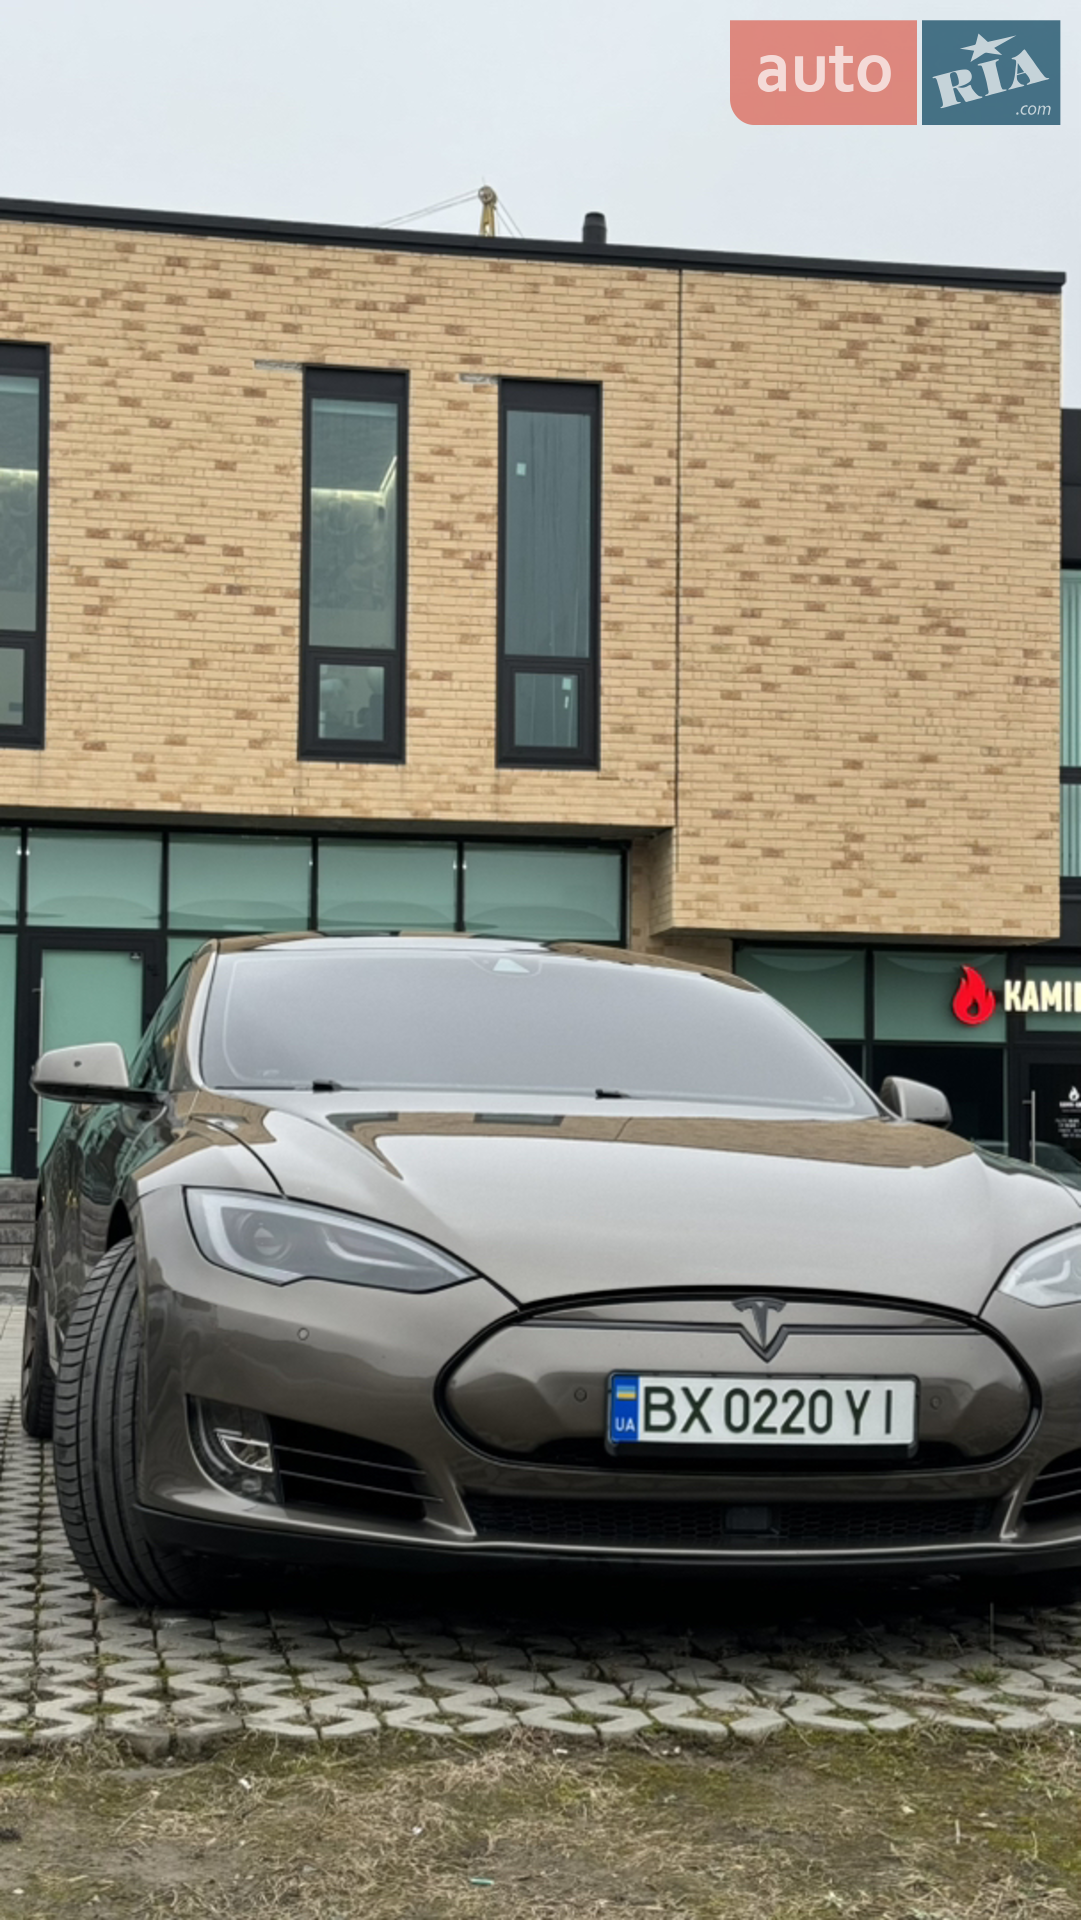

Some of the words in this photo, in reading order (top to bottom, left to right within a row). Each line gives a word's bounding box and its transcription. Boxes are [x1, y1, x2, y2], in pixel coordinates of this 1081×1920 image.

[614, 1416, 636, 1433] UA
[643, 1386, 714, 1434] BX
[723, 1388, 833, 1435] 0220
[845, 1389, 893, 1436] YI
